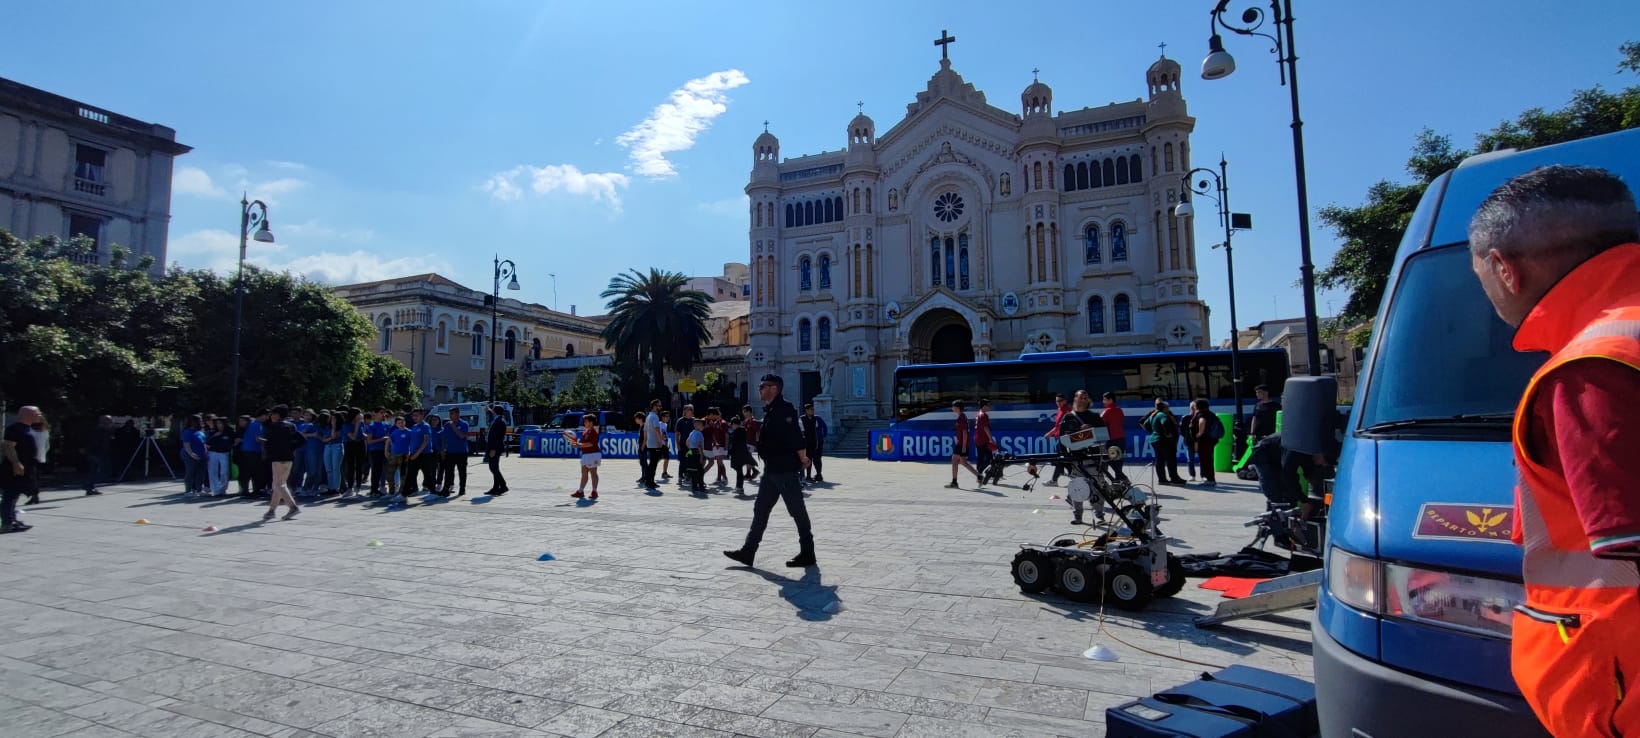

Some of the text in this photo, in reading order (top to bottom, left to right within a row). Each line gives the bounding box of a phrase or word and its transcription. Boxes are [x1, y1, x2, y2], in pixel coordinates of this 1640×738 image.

[597, 437, 639, 455] SSION
[902, 435, 959, 457] RUGB
[991, 435, 1059, 457] SSION
[1426, 510, 1476, 536] REPARTO
